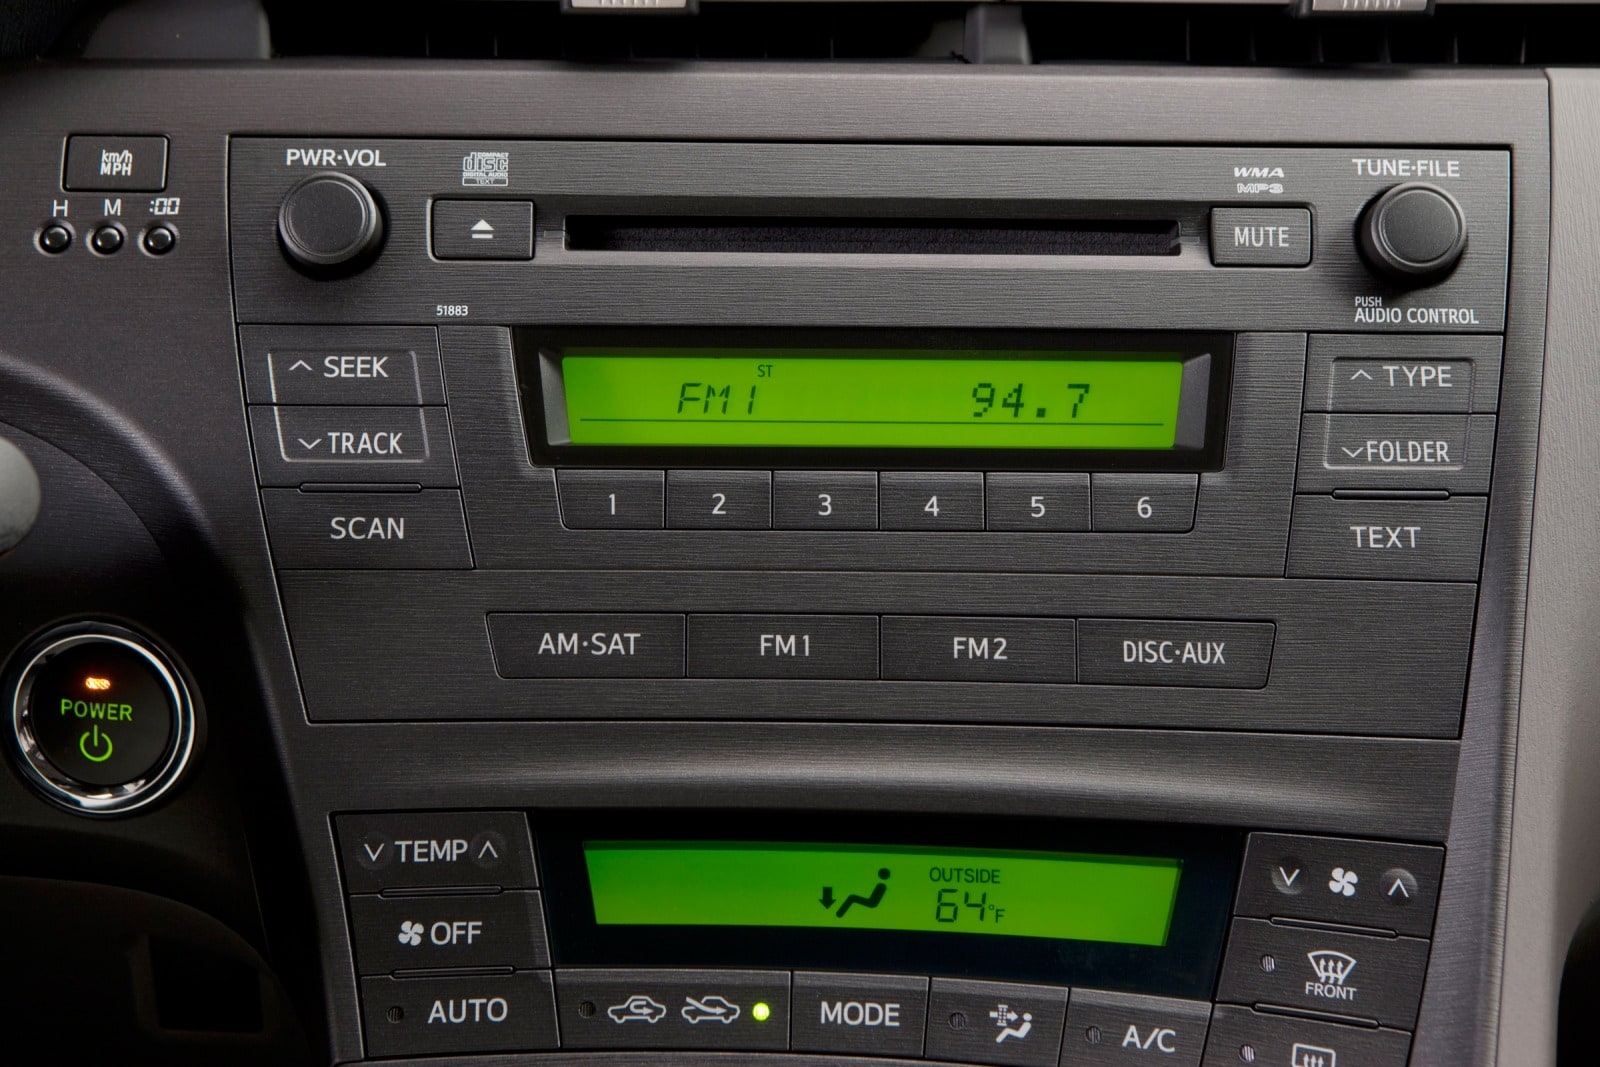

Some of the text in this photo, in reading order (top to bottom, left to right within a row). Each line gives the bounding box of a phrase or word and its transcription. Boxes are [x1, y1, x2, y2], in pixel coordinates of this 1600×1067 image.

[101, 149, 133, 163] km/h
[463, 152, 509, 172] disc
[100, 162, 132, 176] MPH
[1233, 166, 1285, 178] WMA
[1236, 183, 1284, 194] MP3
[52, 199, 69, 217] H
[103, 198, 122, 216] M
[1234, 226, 1290, 248] MUTE
[436, 304, 469, 317] 51883
[1354, 296, 1382, 308] PUSH
[1354, 308, 1479, 325] AUDIO CONTROL
[323, 355, 389, 379] SEEK
[757, 364, 774, 378] ST
[1382, 365, 1453, 388] TYPE
[972, 382, 1091, 418] 94.7
[327, 431, 403, 455] TRACK
[1366, 440, 1450, 463] FOLDER
[608, 493, 616, 516] 1
[711, 493, 727, 516] 2
[817, 493, 833, 517] 3
[924, 495, 940, 517] 4
[1030, 496, 1046, 518] 5
[1136, 496, 1153, 519] 6
[329, 516, 405, 541] SCAN
[1349, 525, 1421, 550] TEXT
[60, 698, 133, 722] POWER
[394, 839, 469, 863] TEMP
[928, 866, 1001, 884] OUTSIDE
[430, 920, 483, 946] OFF
[1305, 981, 1358, 1001] FRONT
[427, 997, 509, 1025] AUTO
[820, 1000, 900, 1027] MODE
[1121, 1024, 1176, 1054] A/C
